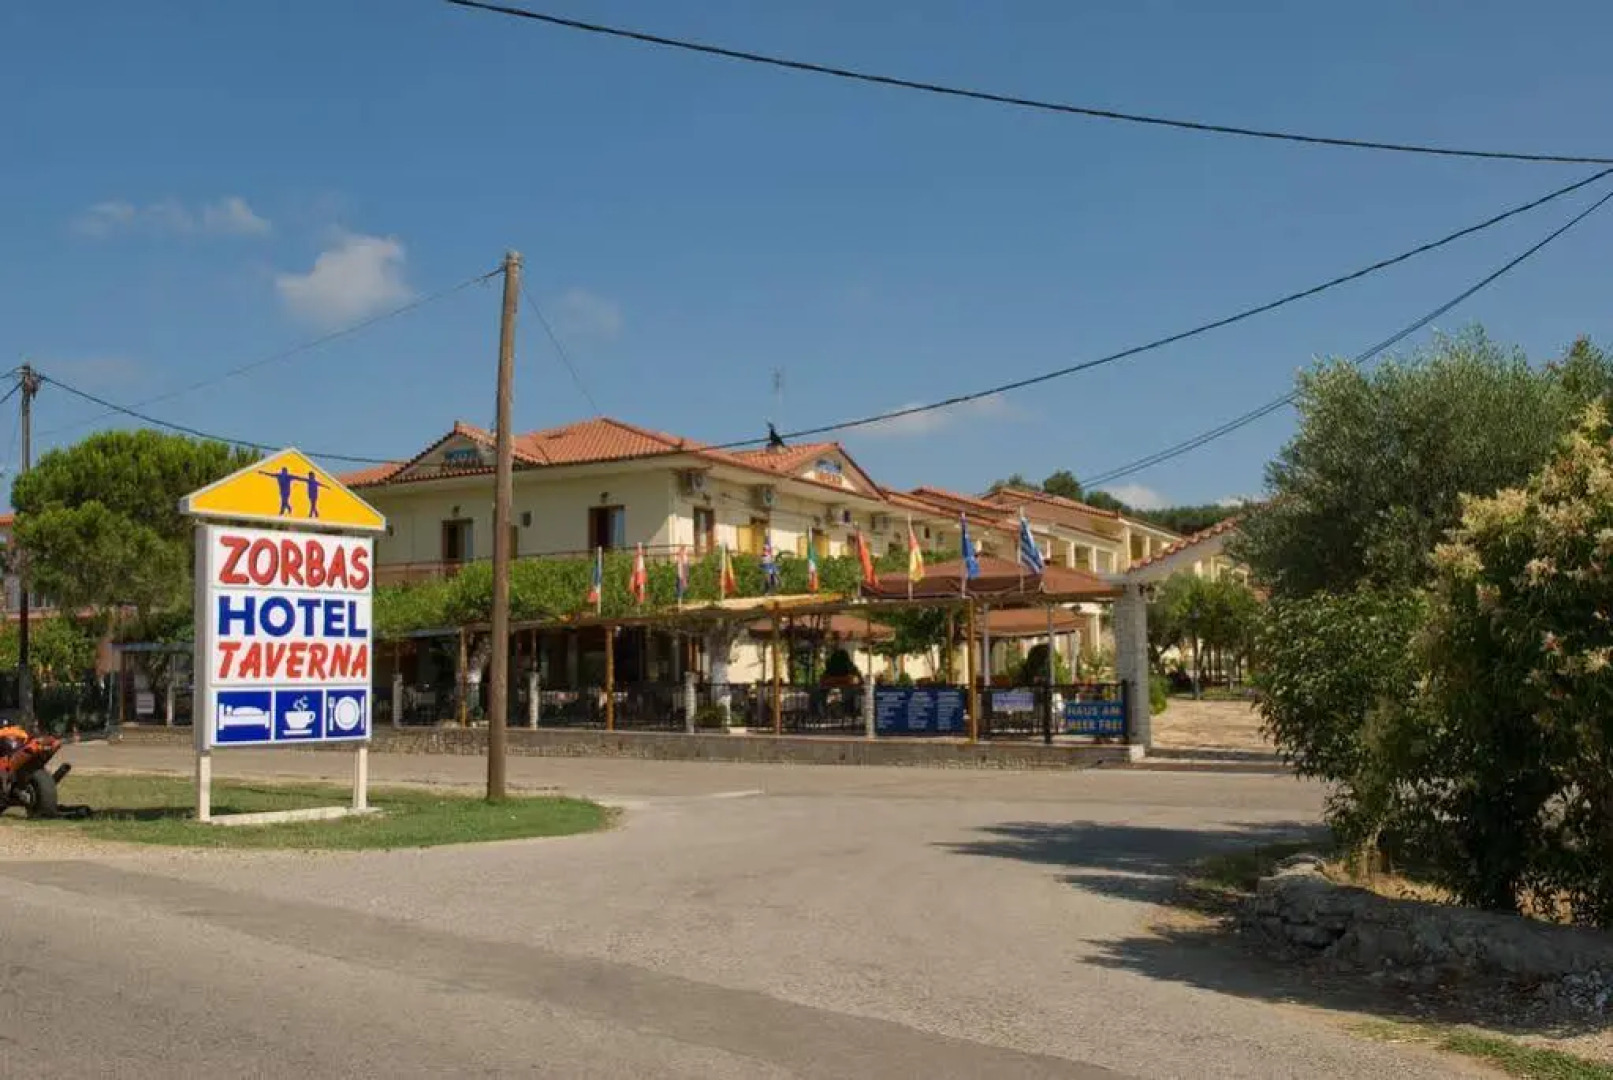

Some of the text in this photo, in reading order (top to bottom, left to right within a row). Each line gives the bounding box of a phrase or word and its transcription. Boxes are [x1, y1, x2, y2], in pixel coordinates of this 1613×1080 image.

[219, 536, 370, 590] ZORBAS
[218, 596, 367, 638] HOTEL
[218, 641, 367, 680] TAVERNA
